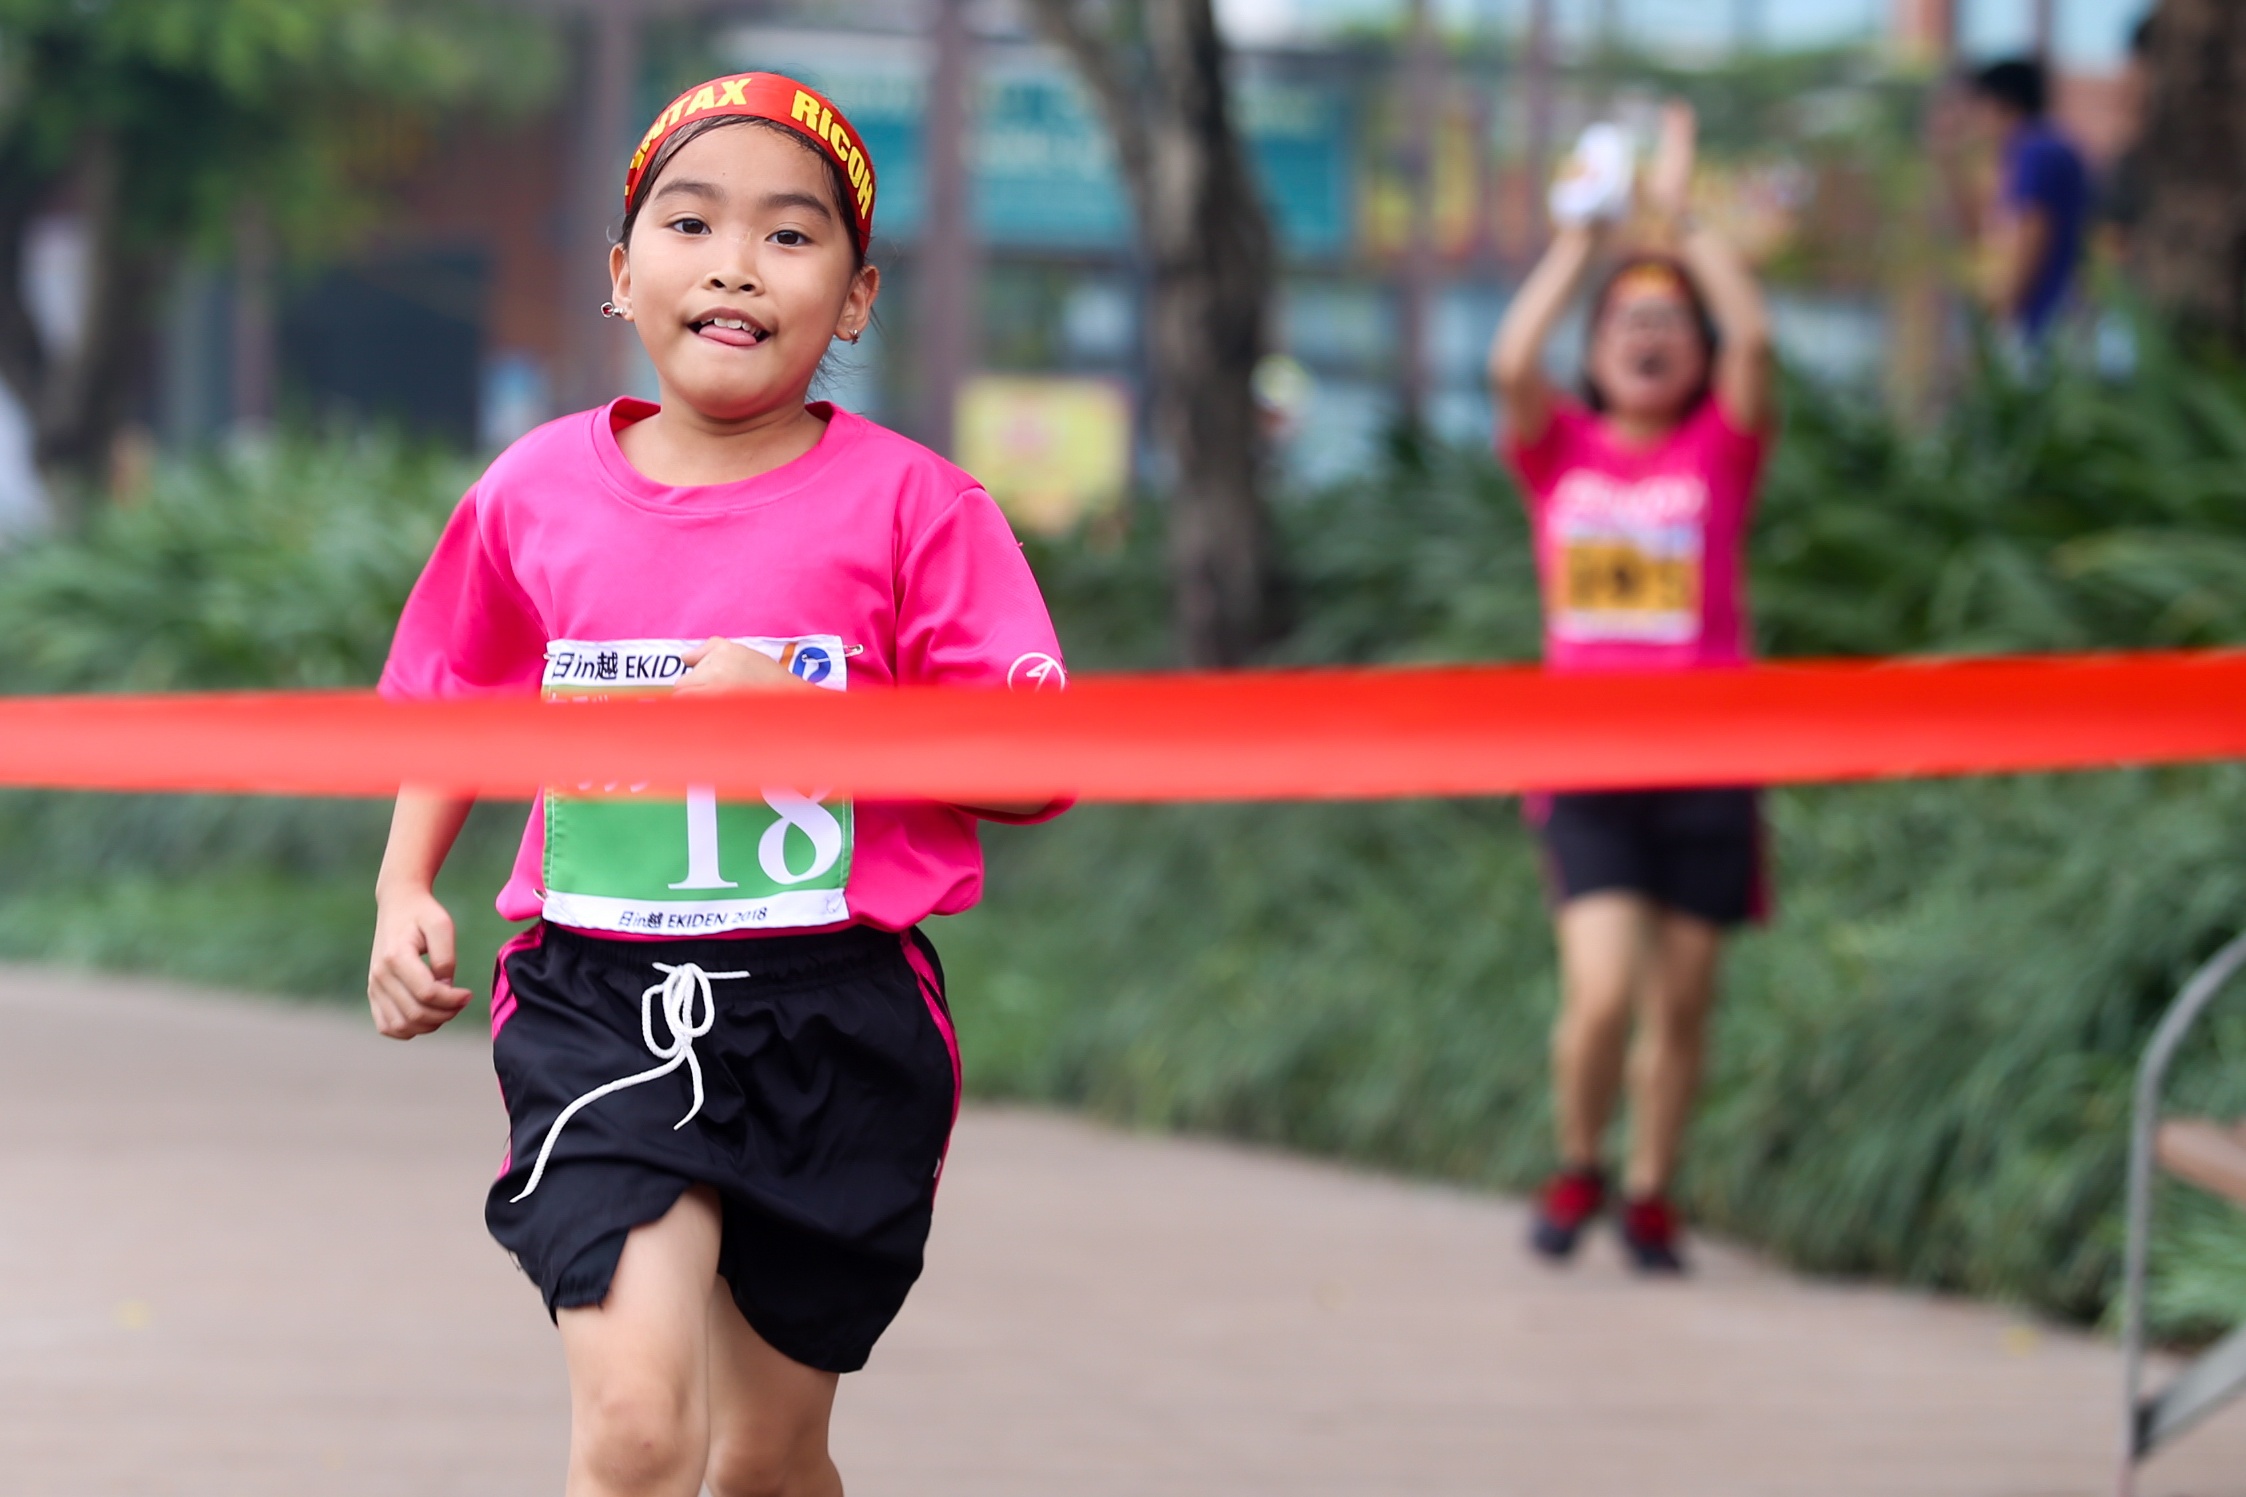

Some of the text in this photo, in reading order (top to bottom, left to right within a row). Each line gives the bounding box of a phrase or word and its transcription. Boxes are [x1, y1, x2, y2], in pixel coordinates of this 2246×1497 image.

[791, 89, 873, 220] RICOH
[625, 655, 692, 679] EKID
[667, 780, 842, 890] 18
[668, 911, 728, 928] EKIDEN
[732, 906, 768, 923] 2018
